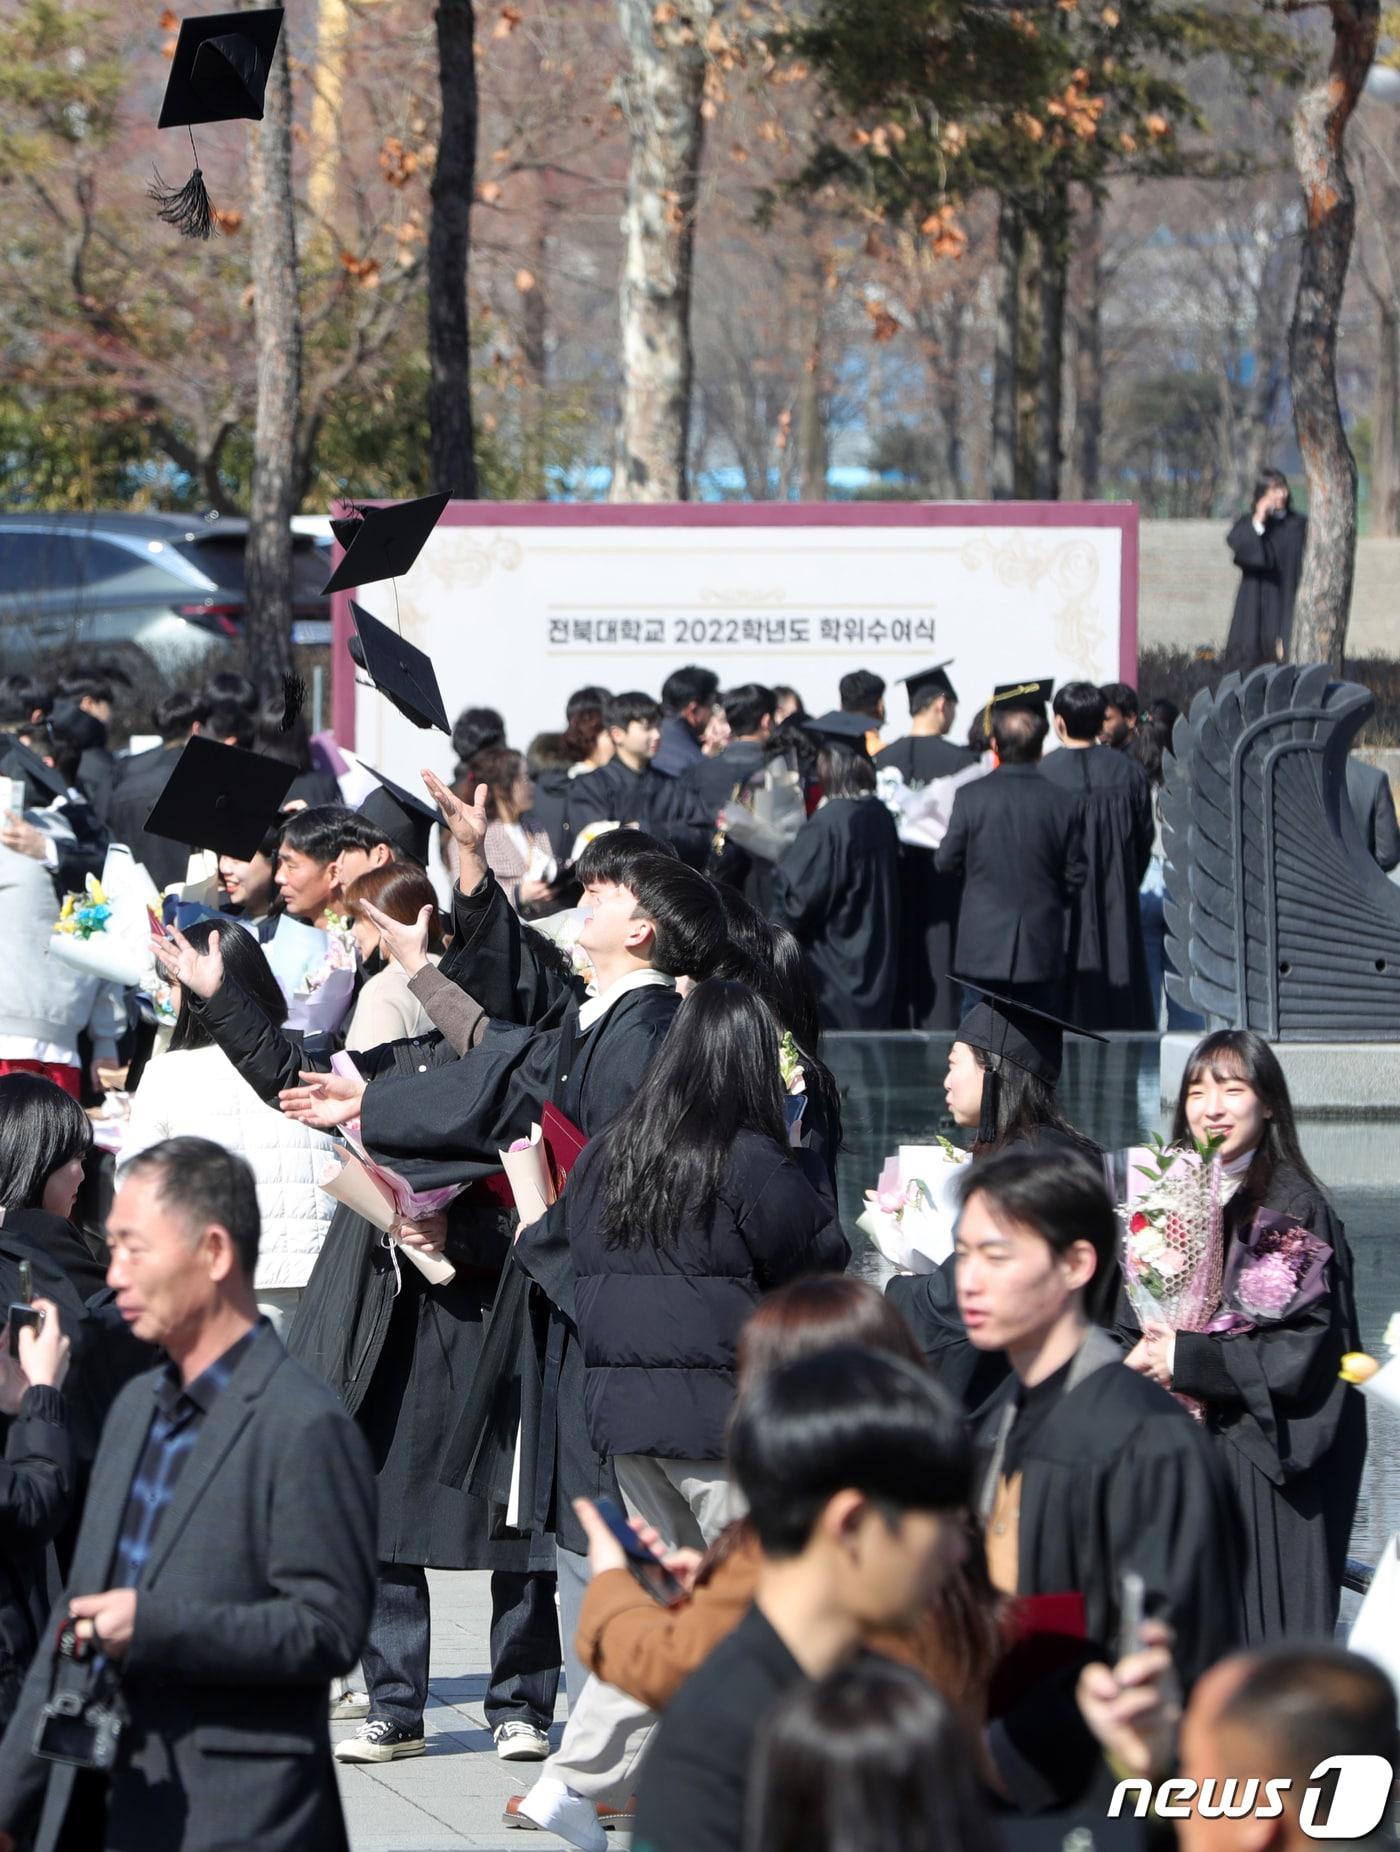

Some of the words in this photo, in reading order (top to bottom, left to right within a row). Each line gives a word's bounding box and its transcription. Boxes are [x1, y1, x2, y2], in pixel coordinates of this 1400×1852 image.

[548, 618, 664, 644] 전북대학교
[674, 618, 810, 643] 2022학년도
[820, 617, 936, 642] 학위수여식
